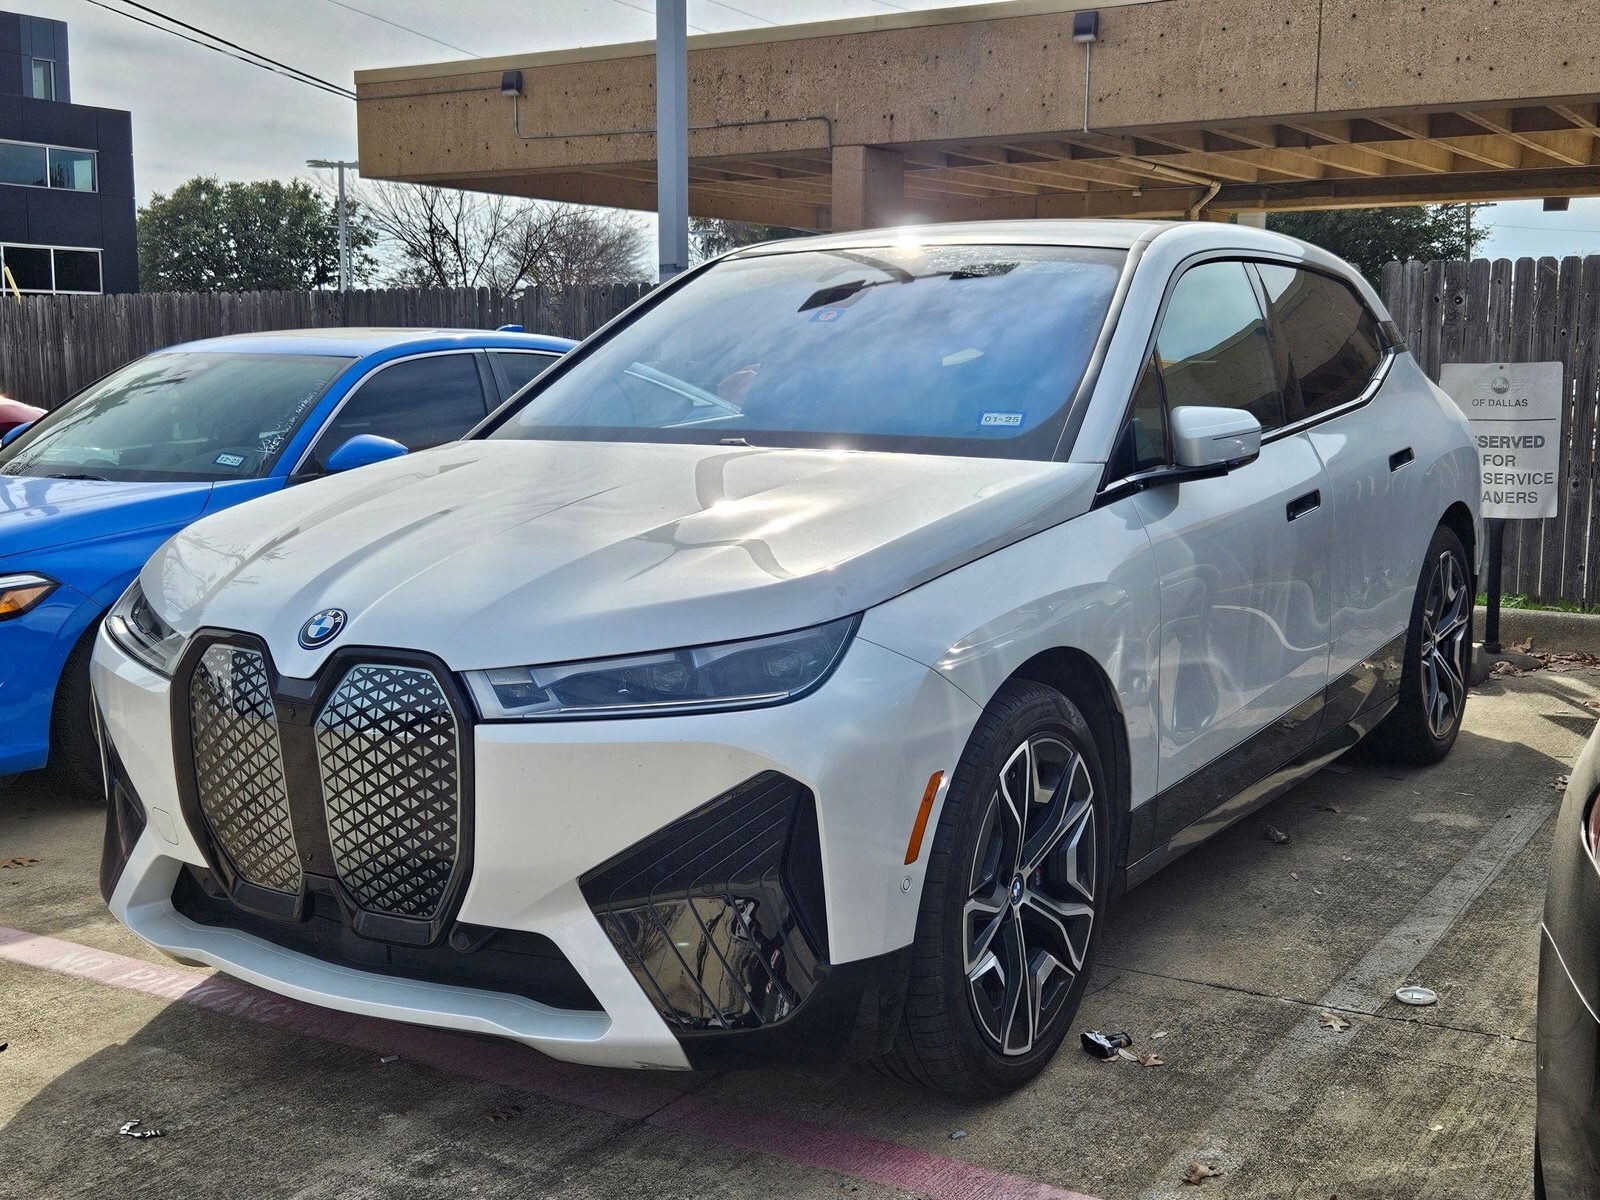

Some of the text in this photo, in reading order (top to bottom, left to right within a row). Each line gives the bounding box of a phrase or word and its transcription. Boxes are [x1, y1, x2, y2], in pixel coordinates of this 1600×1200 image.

[1472, 398, 1528, 407] OF DALLAS
[1475, 435, 1546, 449] SERVED
[1482, 455, 1516, 467] FOR
[1483, 472, 1554, 485] SERVICE
[1482, 491, 1538, 504] ANERS
